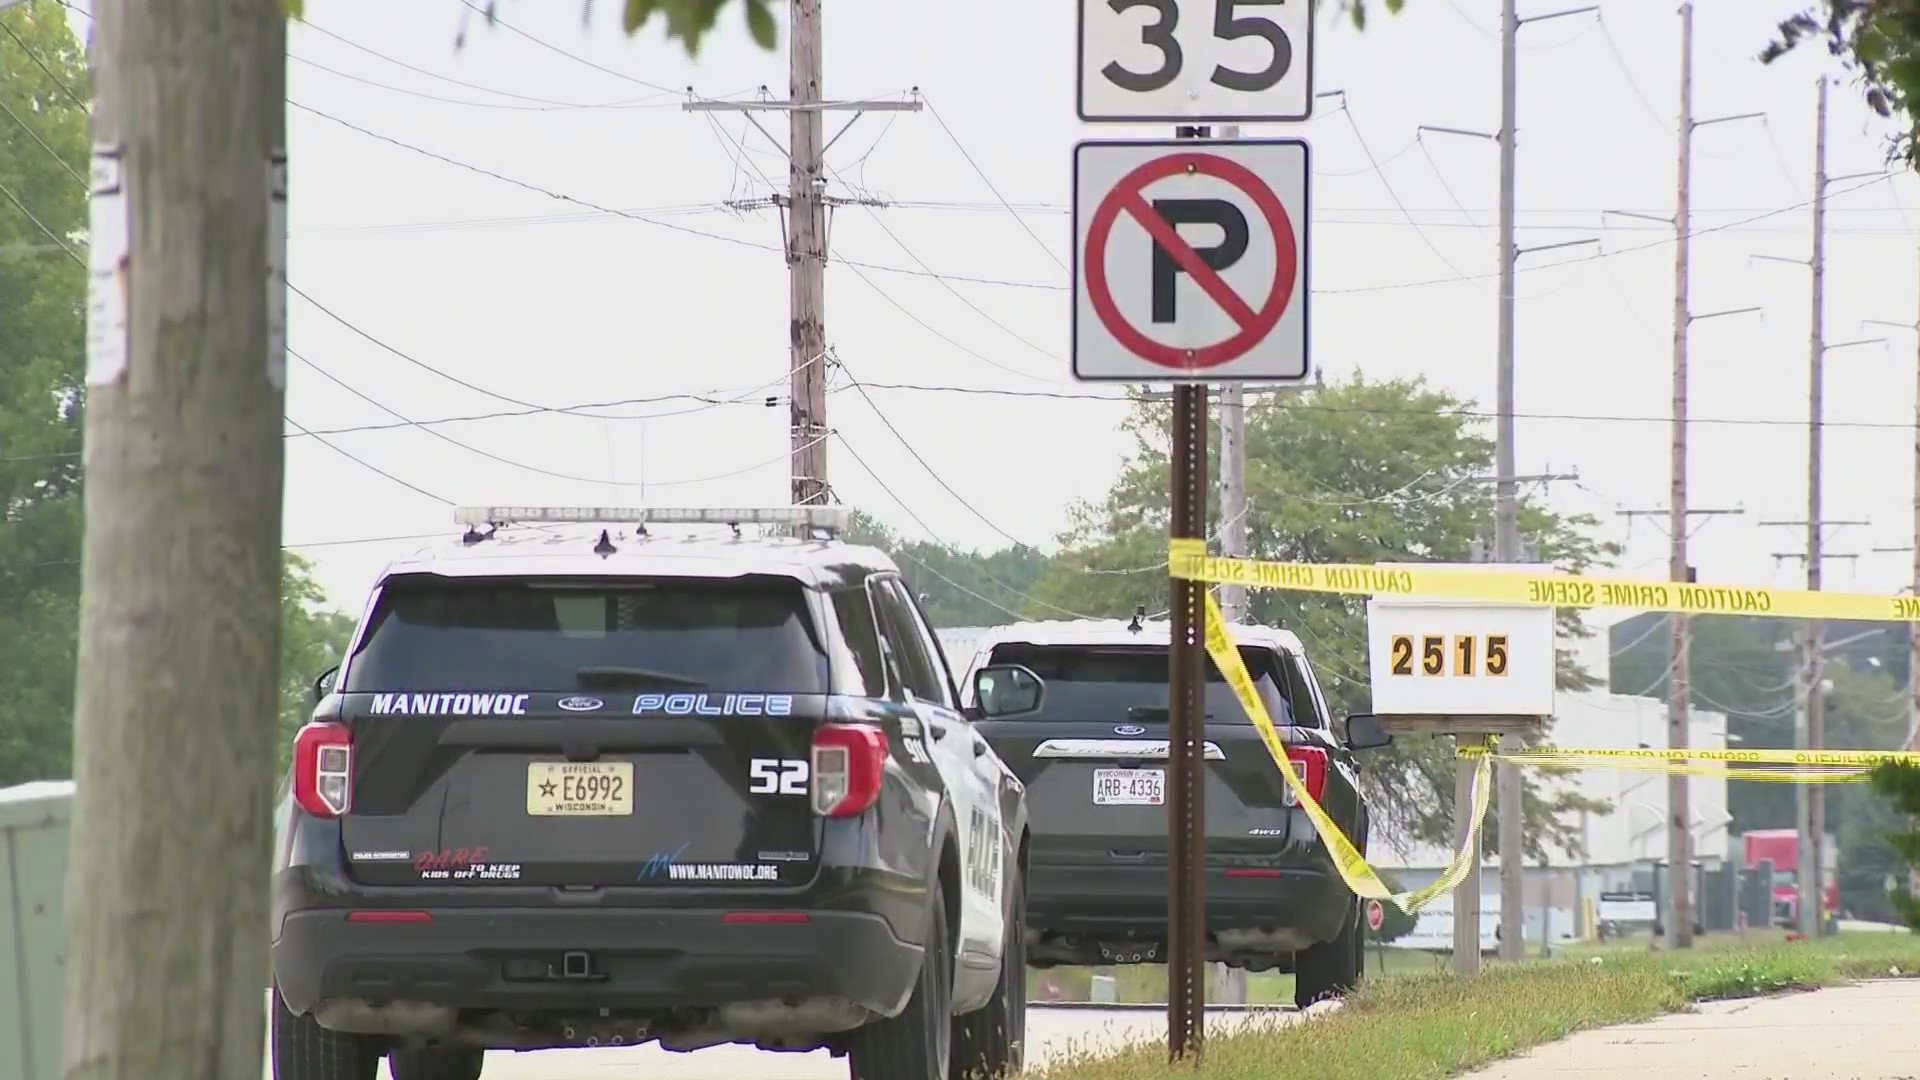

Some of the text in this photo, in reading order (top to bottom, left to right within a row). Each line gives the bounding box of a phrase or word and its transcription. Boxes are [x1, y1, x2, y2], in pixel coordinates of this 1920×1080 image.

[1101, 0, 1292, 92] 35
[1152, 198, 1249, 323] P
[1392, 636, 1507, 675] 2515
[370, 693, 529, 715] MANITOWOC
[632, 694, 793, 715] POLICE
[562, 764, 602, 774] OFFICIAL
[750, 758, 809, 795] 52
[1097, 770, 1134, 778] WISCONSIN
[563, 775, 623, 801] E6992
[1097, 778, 1161, 796] ARB-4336
[555, 802, 606, 811] WISCONSIN
[421, 870, 520, 879] KIDS OFF DRUGS
[470, 863, 521, 872] TO KEEP
[668, 864, 778, 880] WWW.MANITOWOC.ORG
